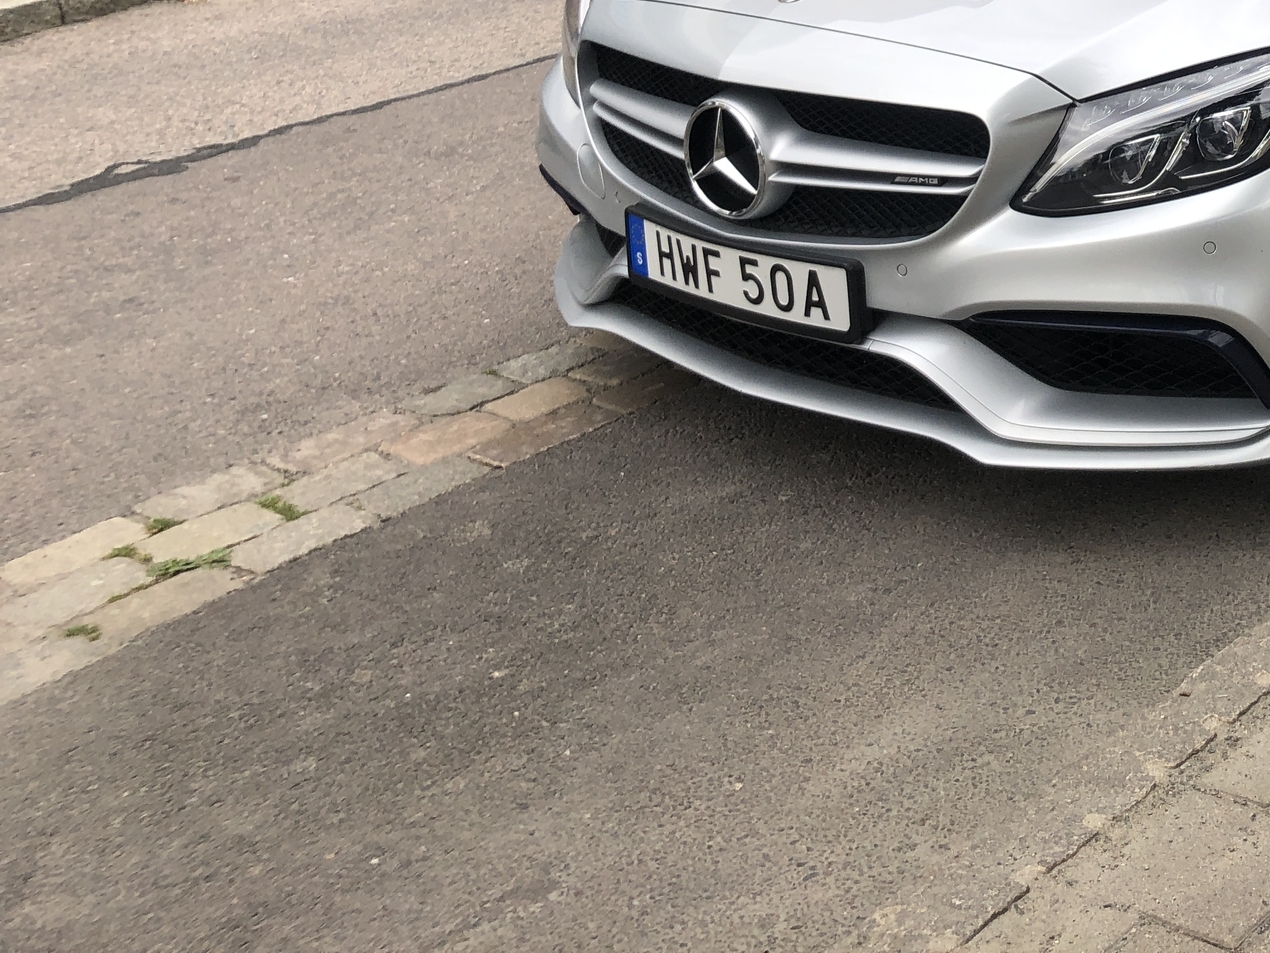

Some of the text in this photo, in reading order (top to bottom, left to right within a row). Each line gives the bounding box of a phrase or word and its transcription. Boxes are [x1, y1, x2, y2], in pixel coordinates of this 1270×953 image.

[908, 176, 939, 184] AMG
[636, 251, 643, 265] S
[655, 229, 831, 321] HWF 50A
